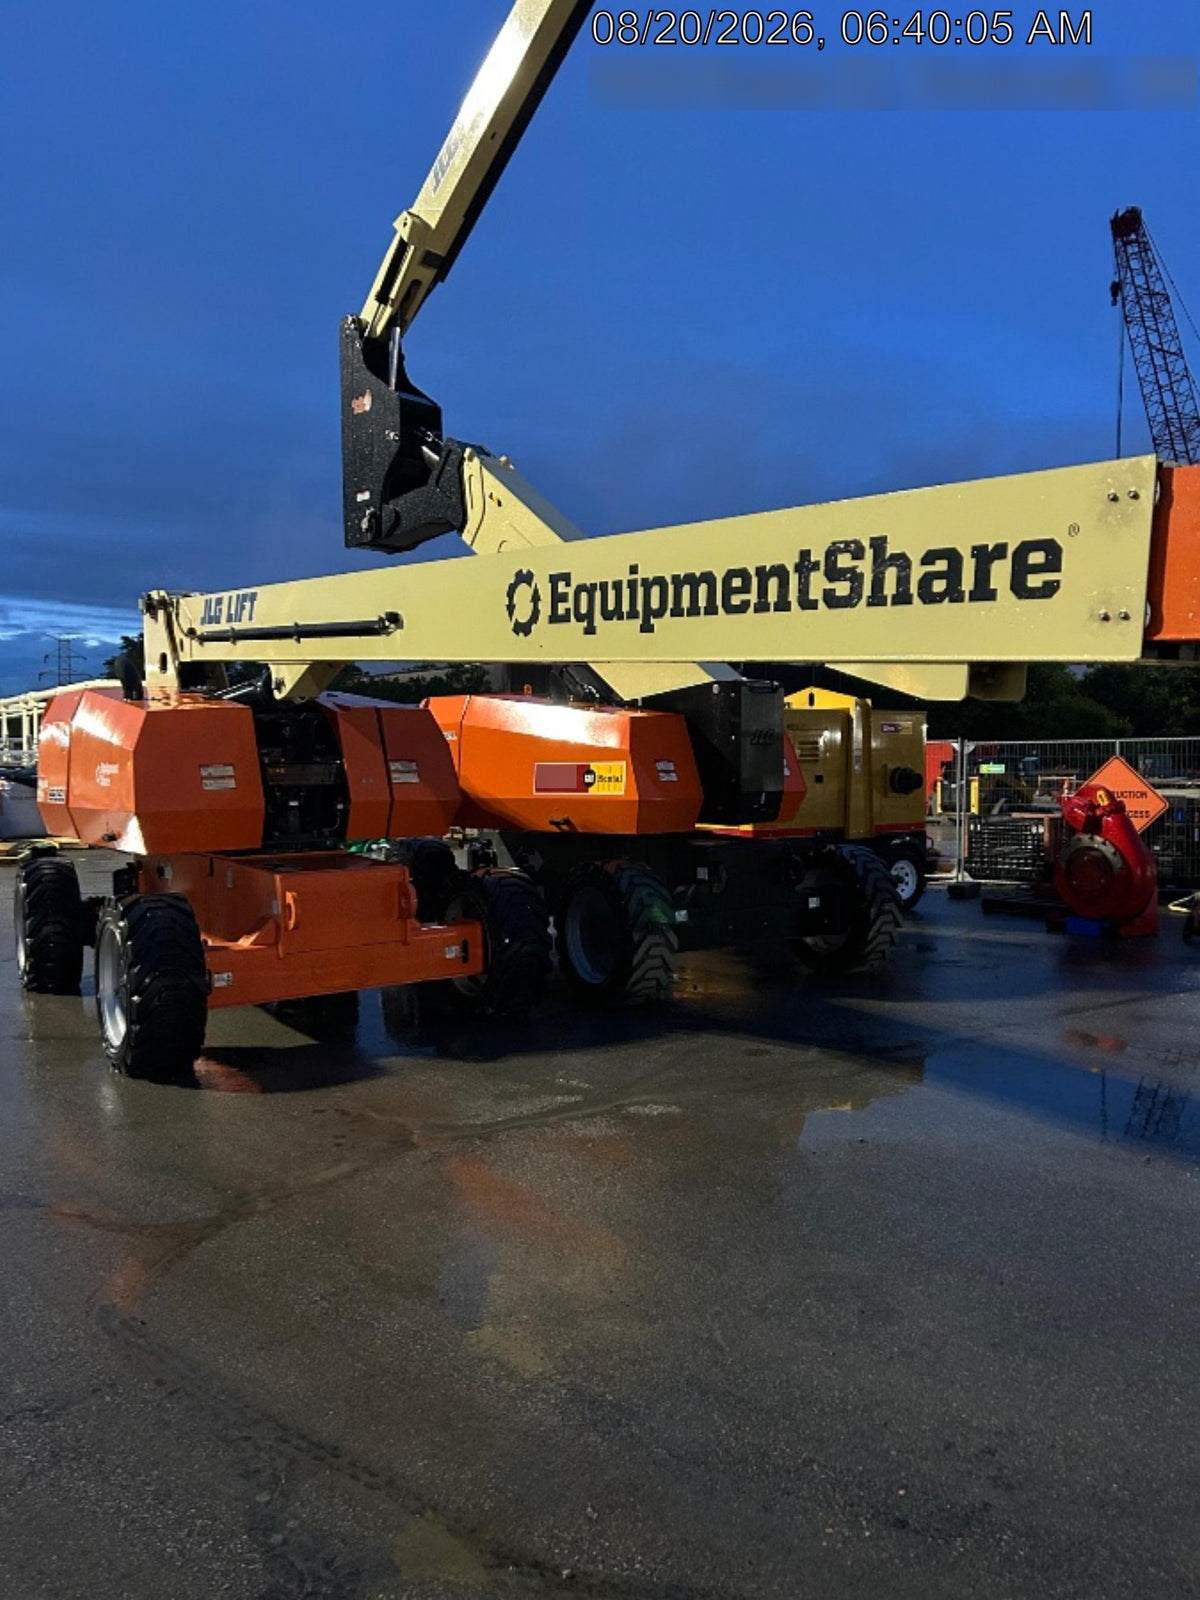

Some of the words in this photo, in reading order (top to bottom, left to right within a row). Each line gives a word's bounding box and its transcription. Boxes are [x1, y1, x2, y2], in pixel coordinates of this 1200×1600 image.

[200, 597, 224, 625] JLG
[226, 592, 258, 623] LIFT
[548, 535, 1062, 635] EquipmentShare
